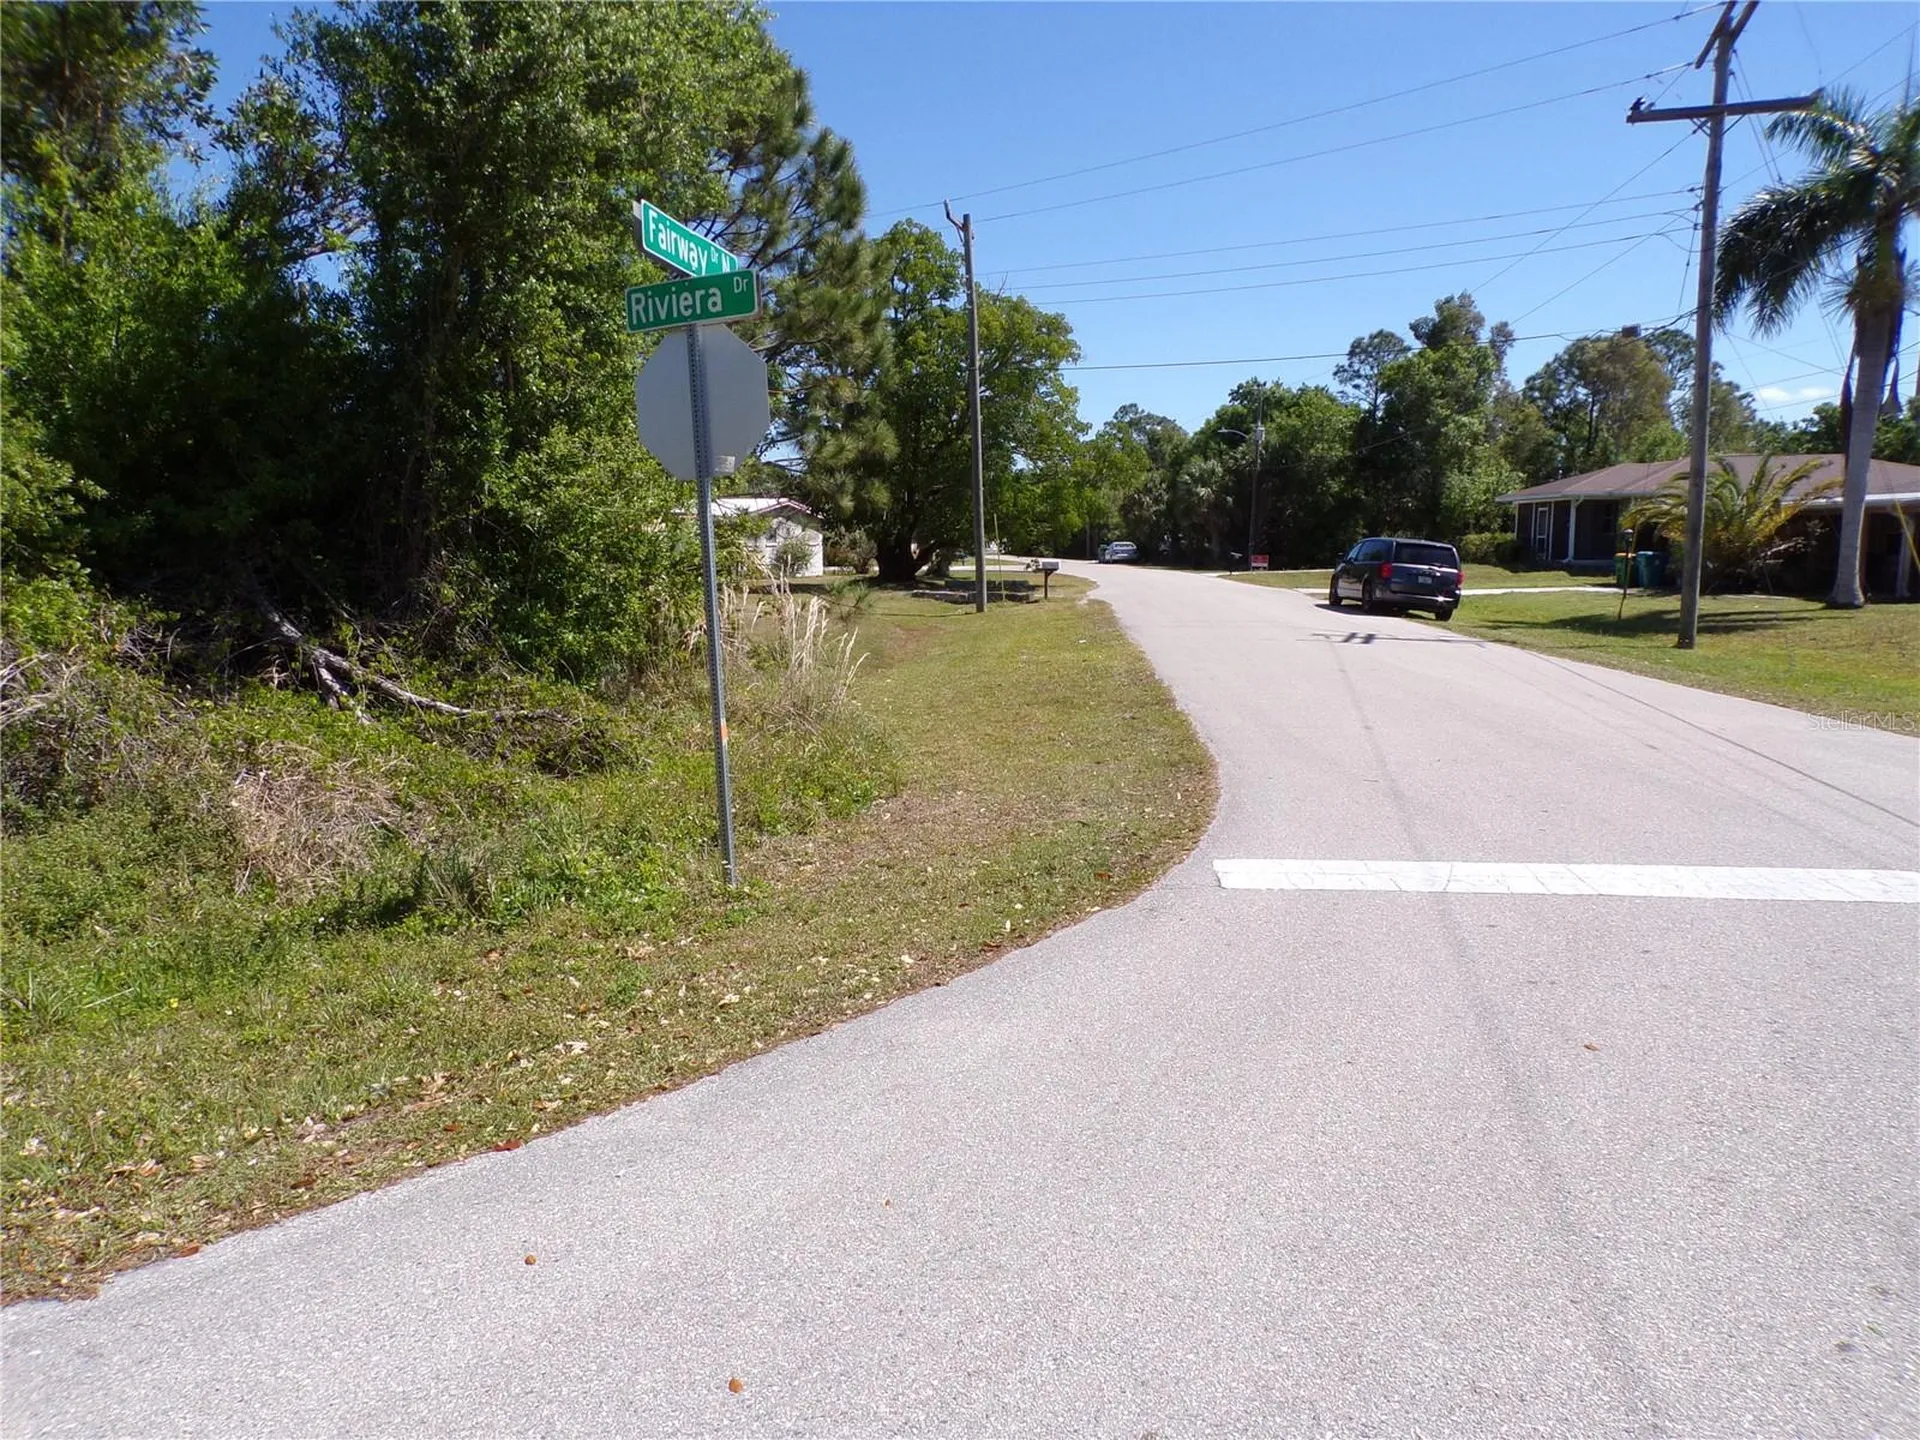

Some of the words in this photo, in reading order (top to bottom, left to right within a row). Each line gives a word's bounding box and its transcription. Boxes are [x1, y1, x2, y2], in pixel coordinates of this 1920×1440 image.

[648, 209, 707, 276] Fairway
[711, 247, 719, 265] Dr
[722, 253, 731, 273] N
[630, 287, 723, 325] Riviera
[733, 276, 749, 293] Dr
